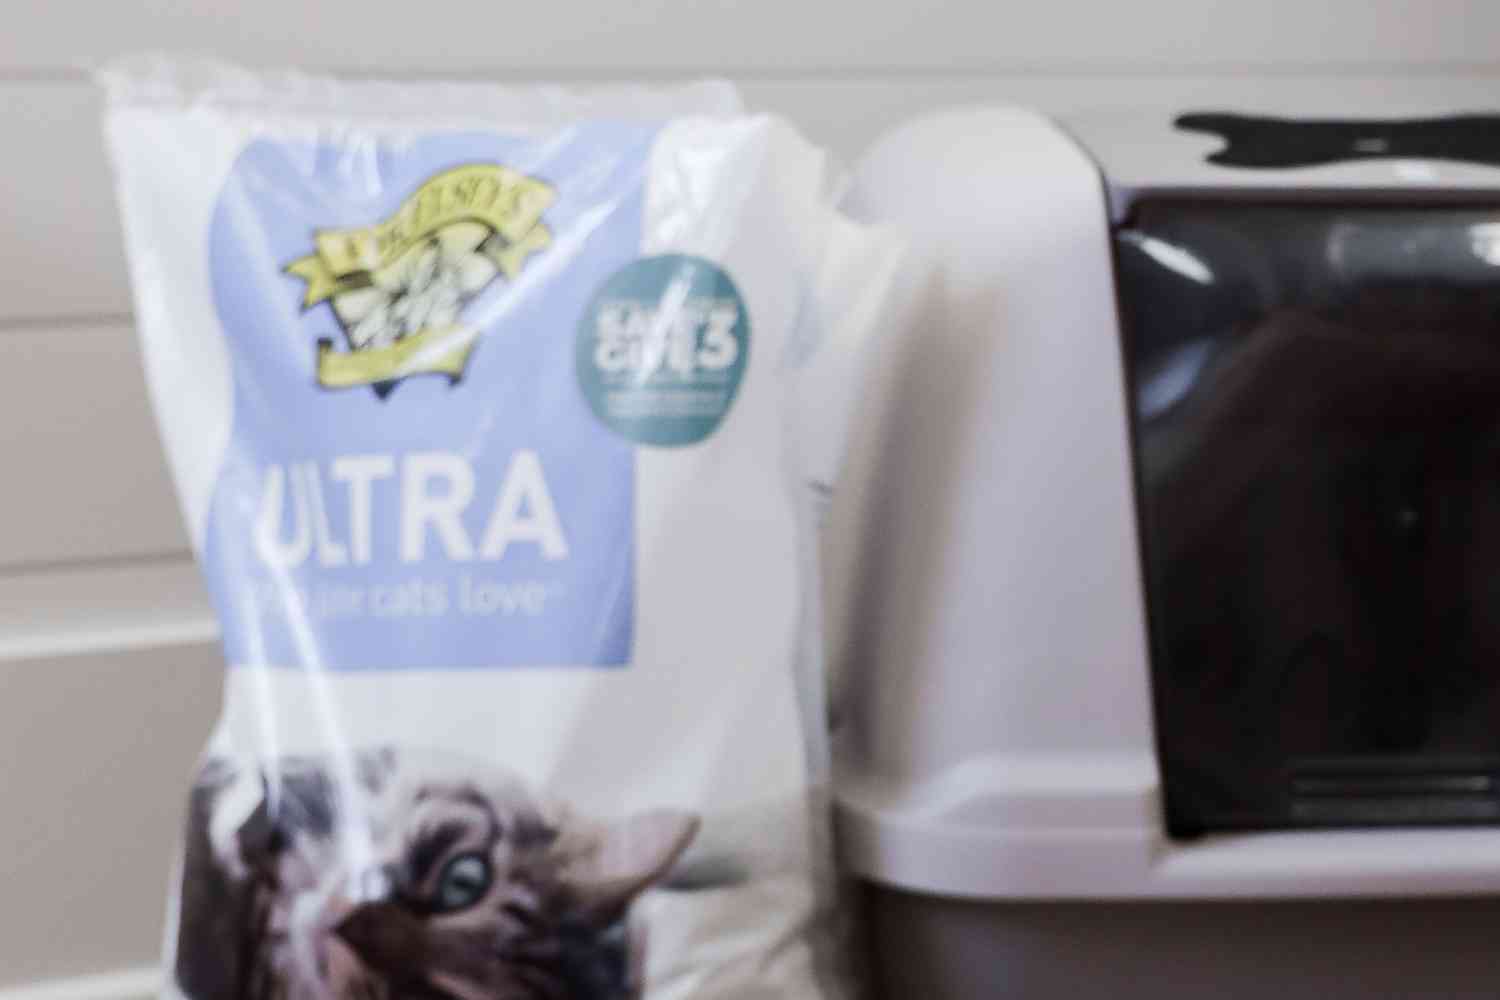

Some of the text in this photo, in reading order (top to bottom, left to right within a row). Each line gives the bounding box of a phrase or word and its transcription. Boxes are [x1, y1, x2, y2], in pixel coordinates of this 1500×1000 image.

[255, 450, 570, 568] ULTRA
[367, 577, 449, 617] cats
[457, 573, 546, 617] love
